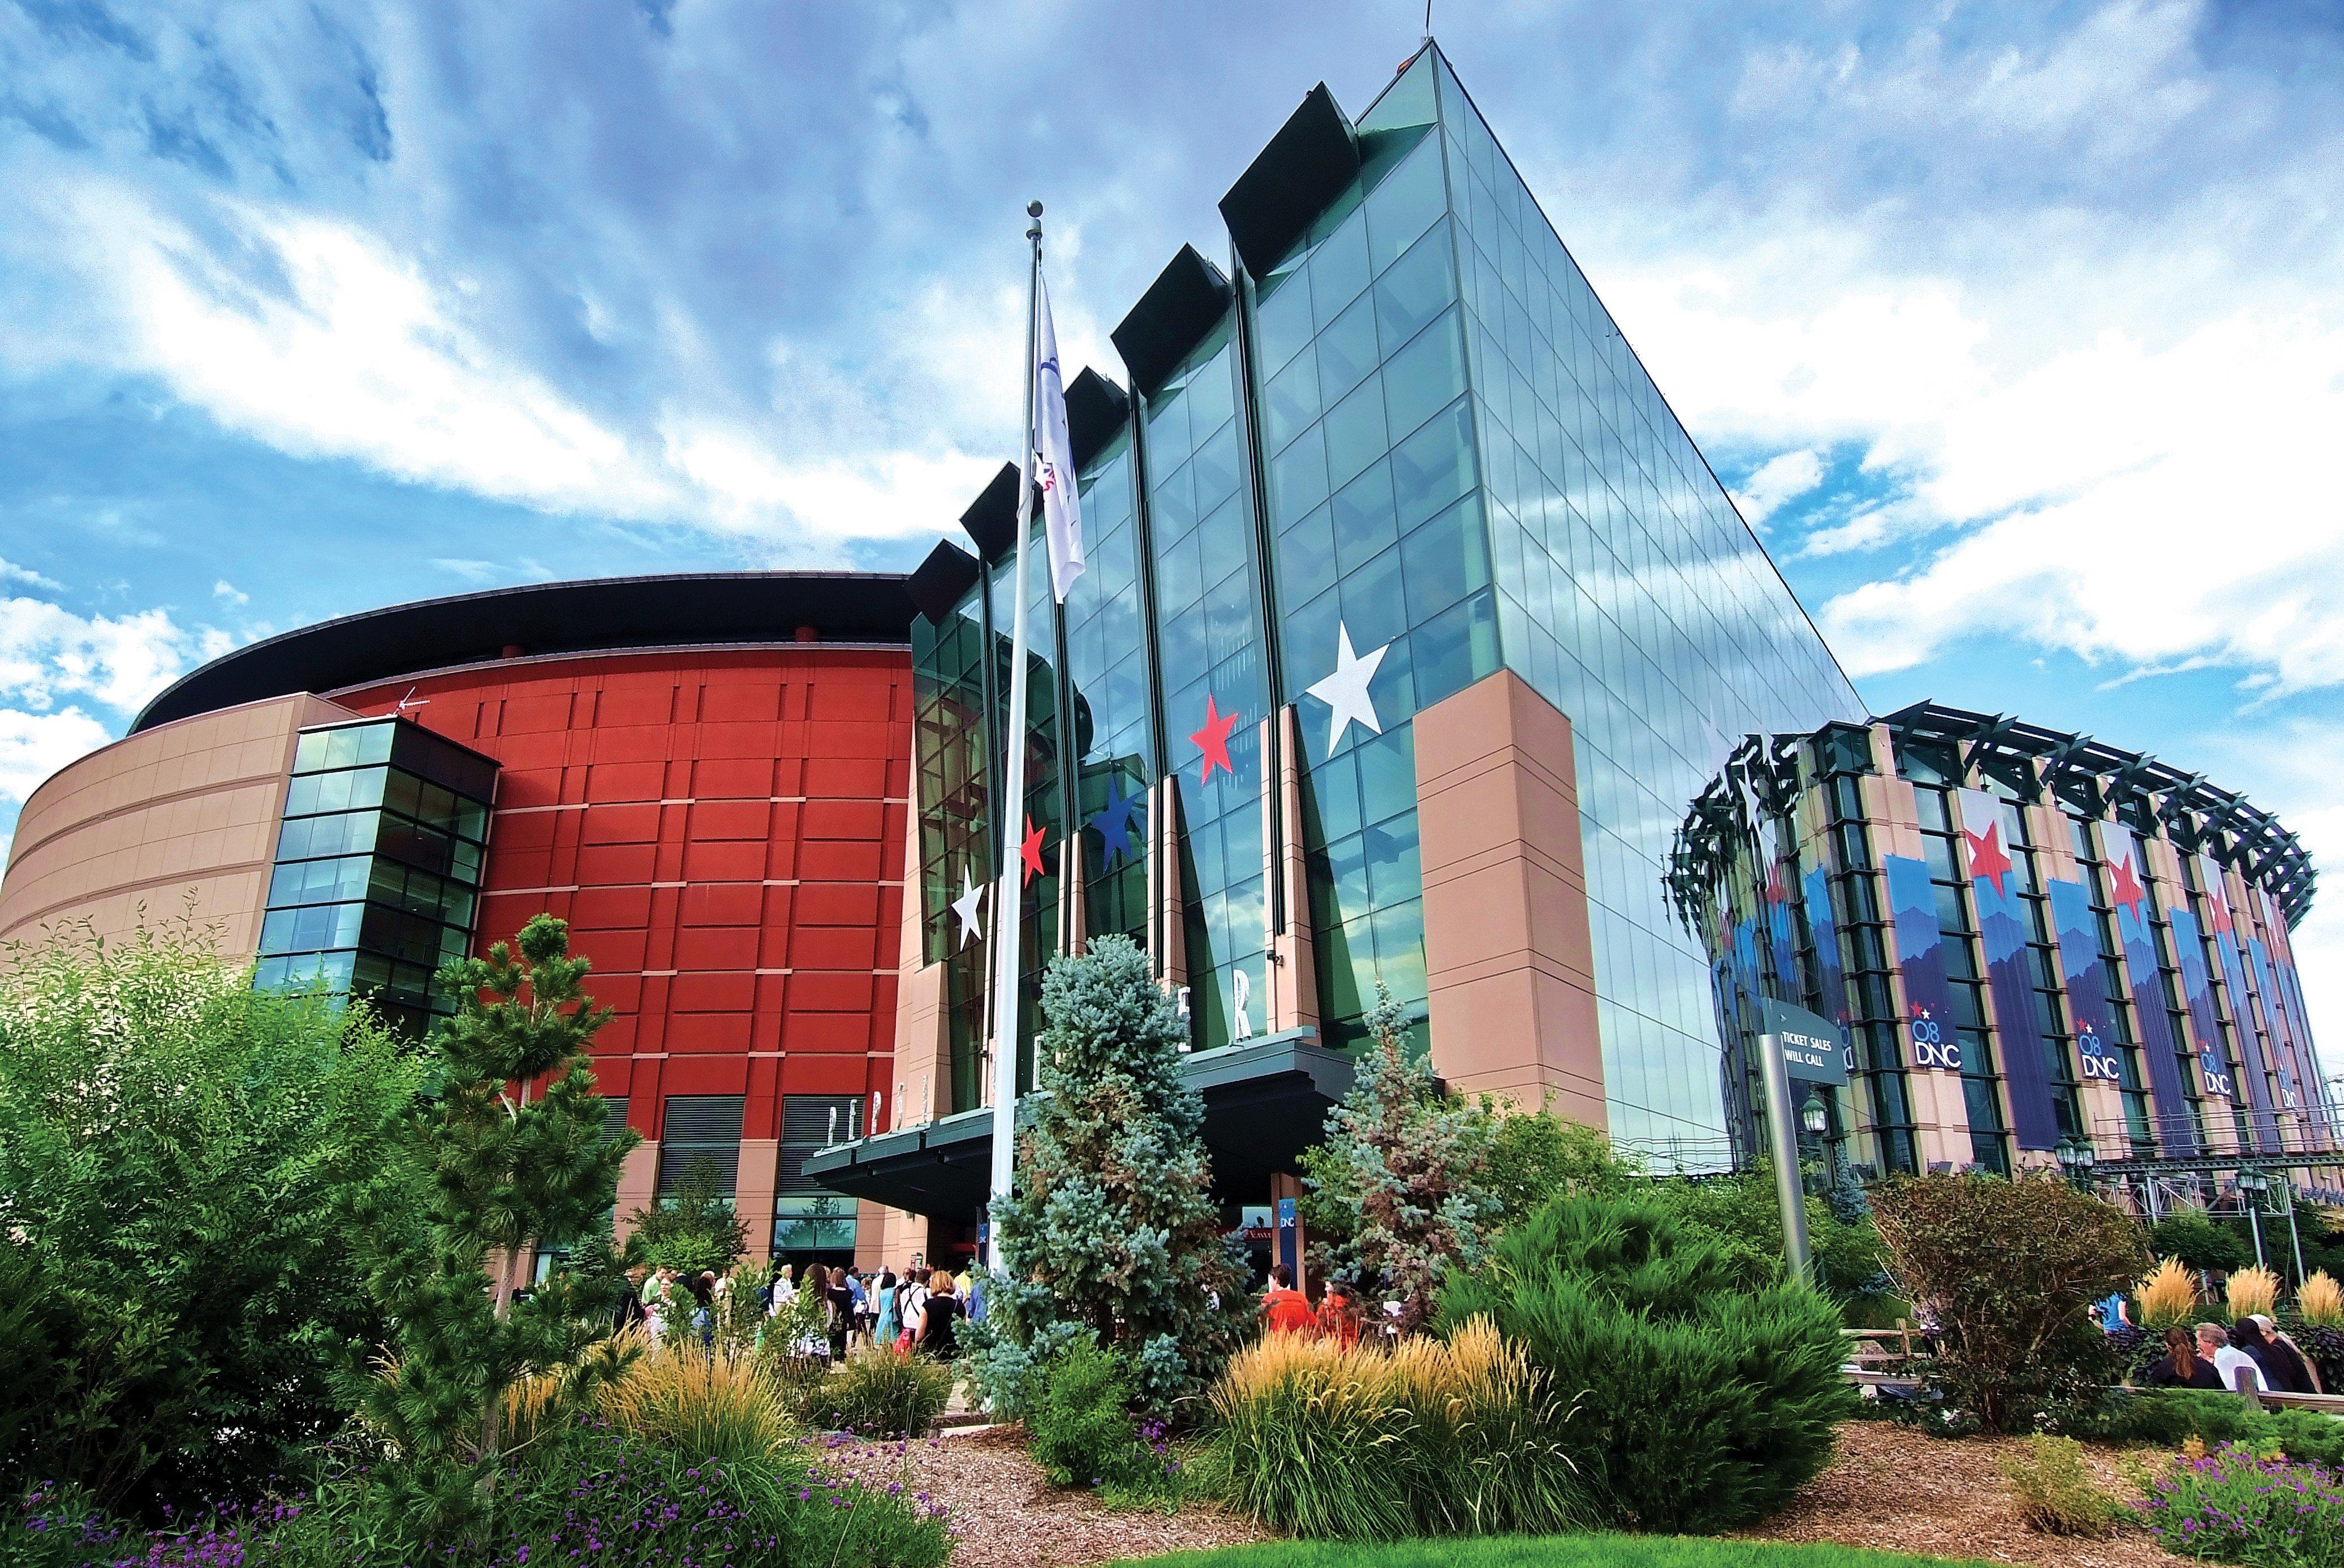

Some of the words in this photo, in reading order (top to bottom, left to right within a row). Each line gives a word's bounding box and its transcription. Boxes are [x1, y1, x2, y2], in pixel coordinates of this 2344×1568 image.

[1782, 1031, 1808, 1046] TICKET
[1810, 1037, 1832, 1052] SALES
[1912, 1020, 1940, 1043] 08
[1915, 1041, 1961, 1067] DNC
[2079, 1035, 2102, 1056] 08
[1785, 1049, 1804, 1063] WILL
[1805, 1053, 1824, 1067] CALL
[2082, 1055, 2119, 1079] DNC
[2204, 1071, 2230, 1095] DNC
[1281, 1217, 1295, 1228] DNC
[1249, 1229, 1272, 1239] Entr
